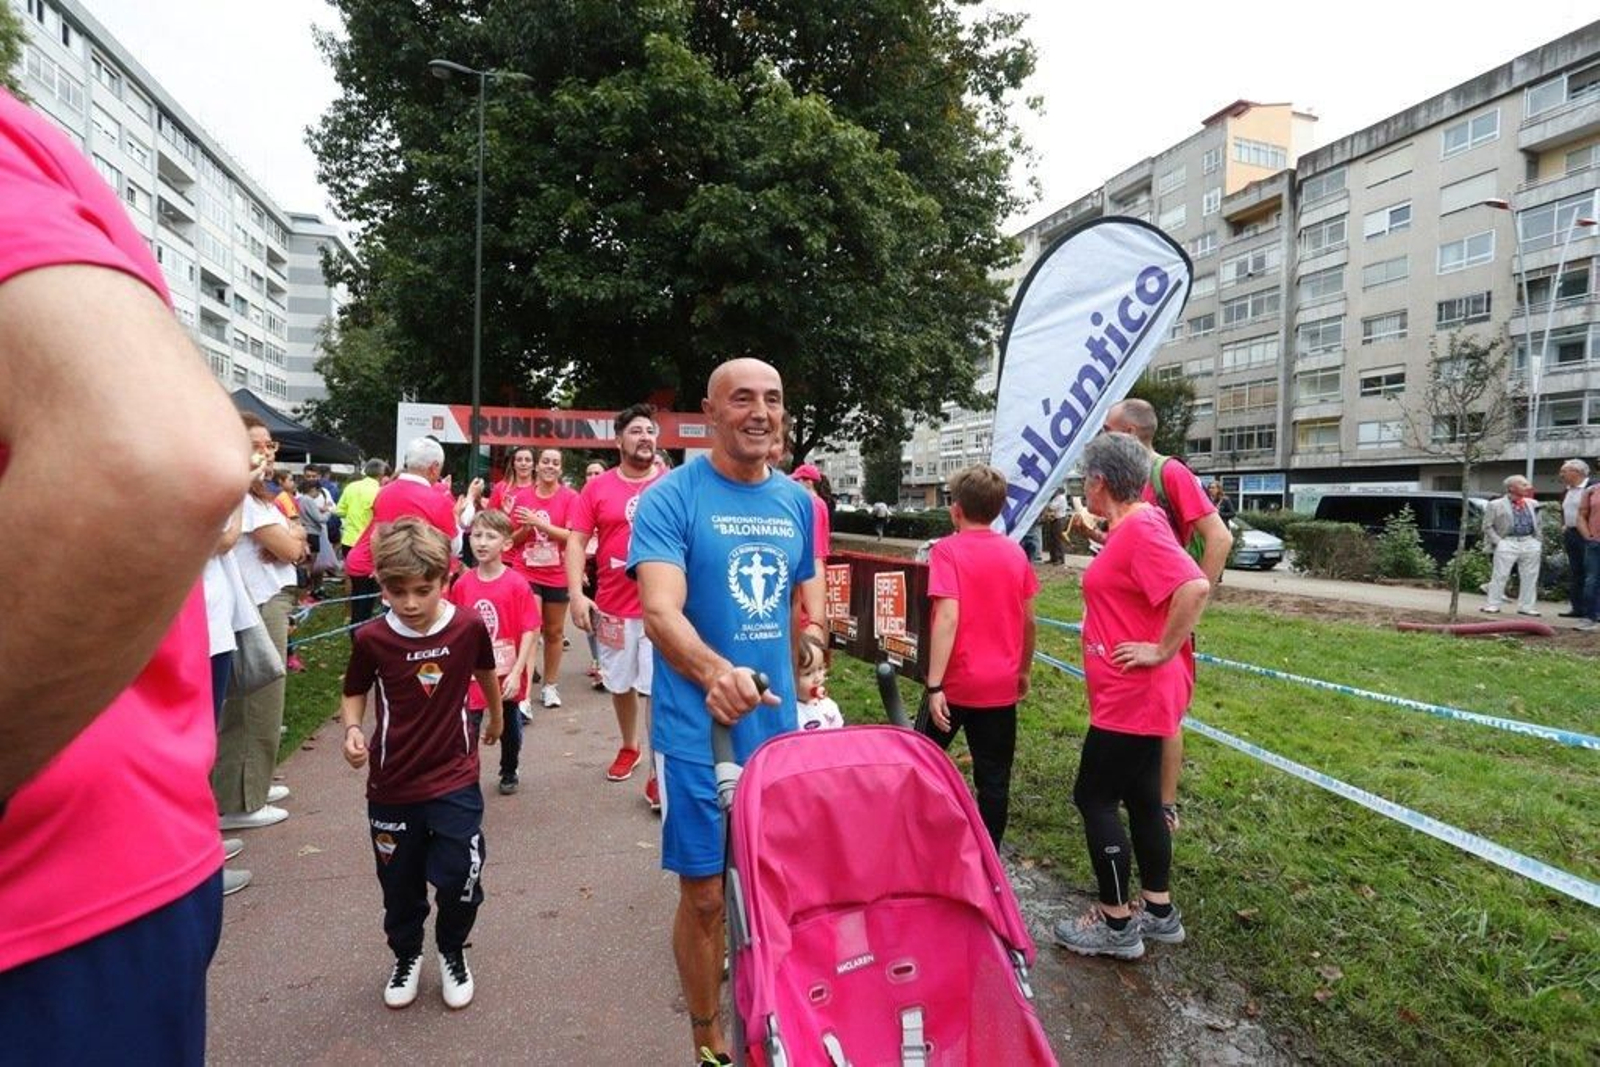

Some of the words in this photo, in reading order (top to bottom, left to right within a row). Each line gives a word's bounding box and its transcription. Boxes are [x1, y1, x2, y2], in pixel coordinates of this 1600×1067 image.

[1001, 265, 1169, 536] Atlántico
[711, 515, 763, 525] CAMPEONATO
[720, 523, 795, 538] BALONMANO
[406, 646, 450, 661] LEGEA
[370, 817, 407, 831] LEGEA
